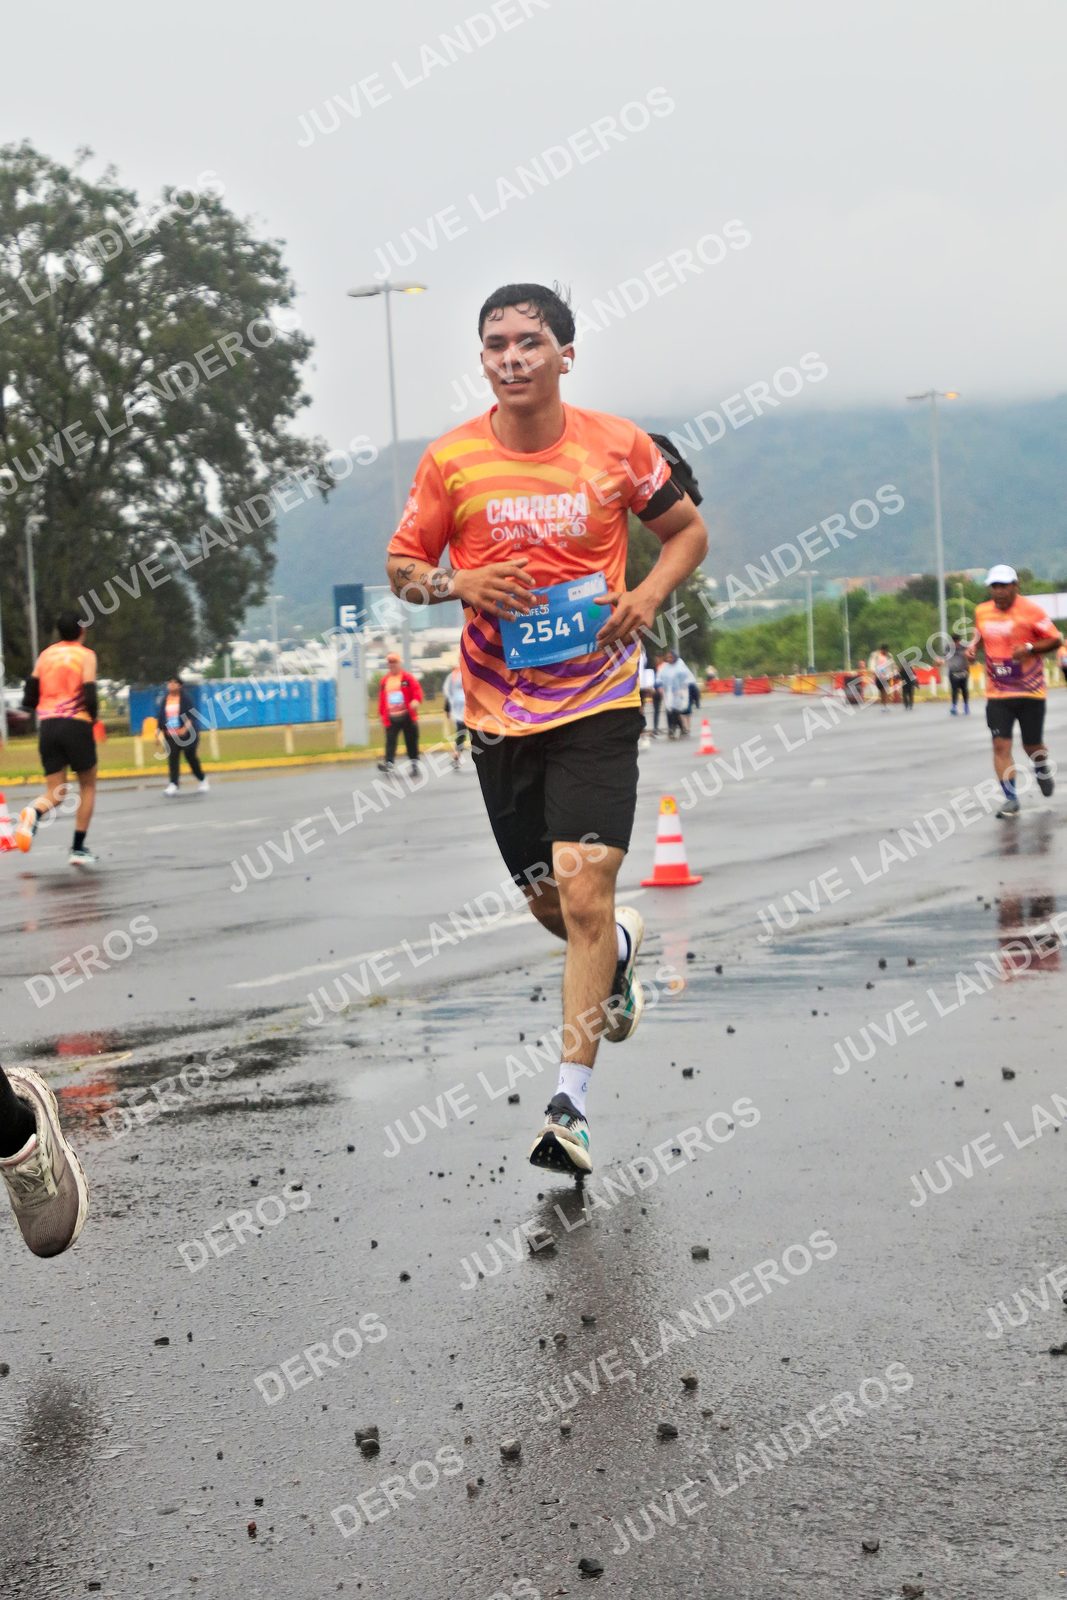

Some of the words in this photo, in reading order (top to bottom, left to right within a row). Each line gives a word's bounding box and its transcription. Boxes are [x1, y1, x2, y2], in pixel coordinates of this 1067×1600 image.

[487, 492, 587, 524] CARRERA
[340, 605, 357, 627] E
[519, 611, 585, 644] 2541
